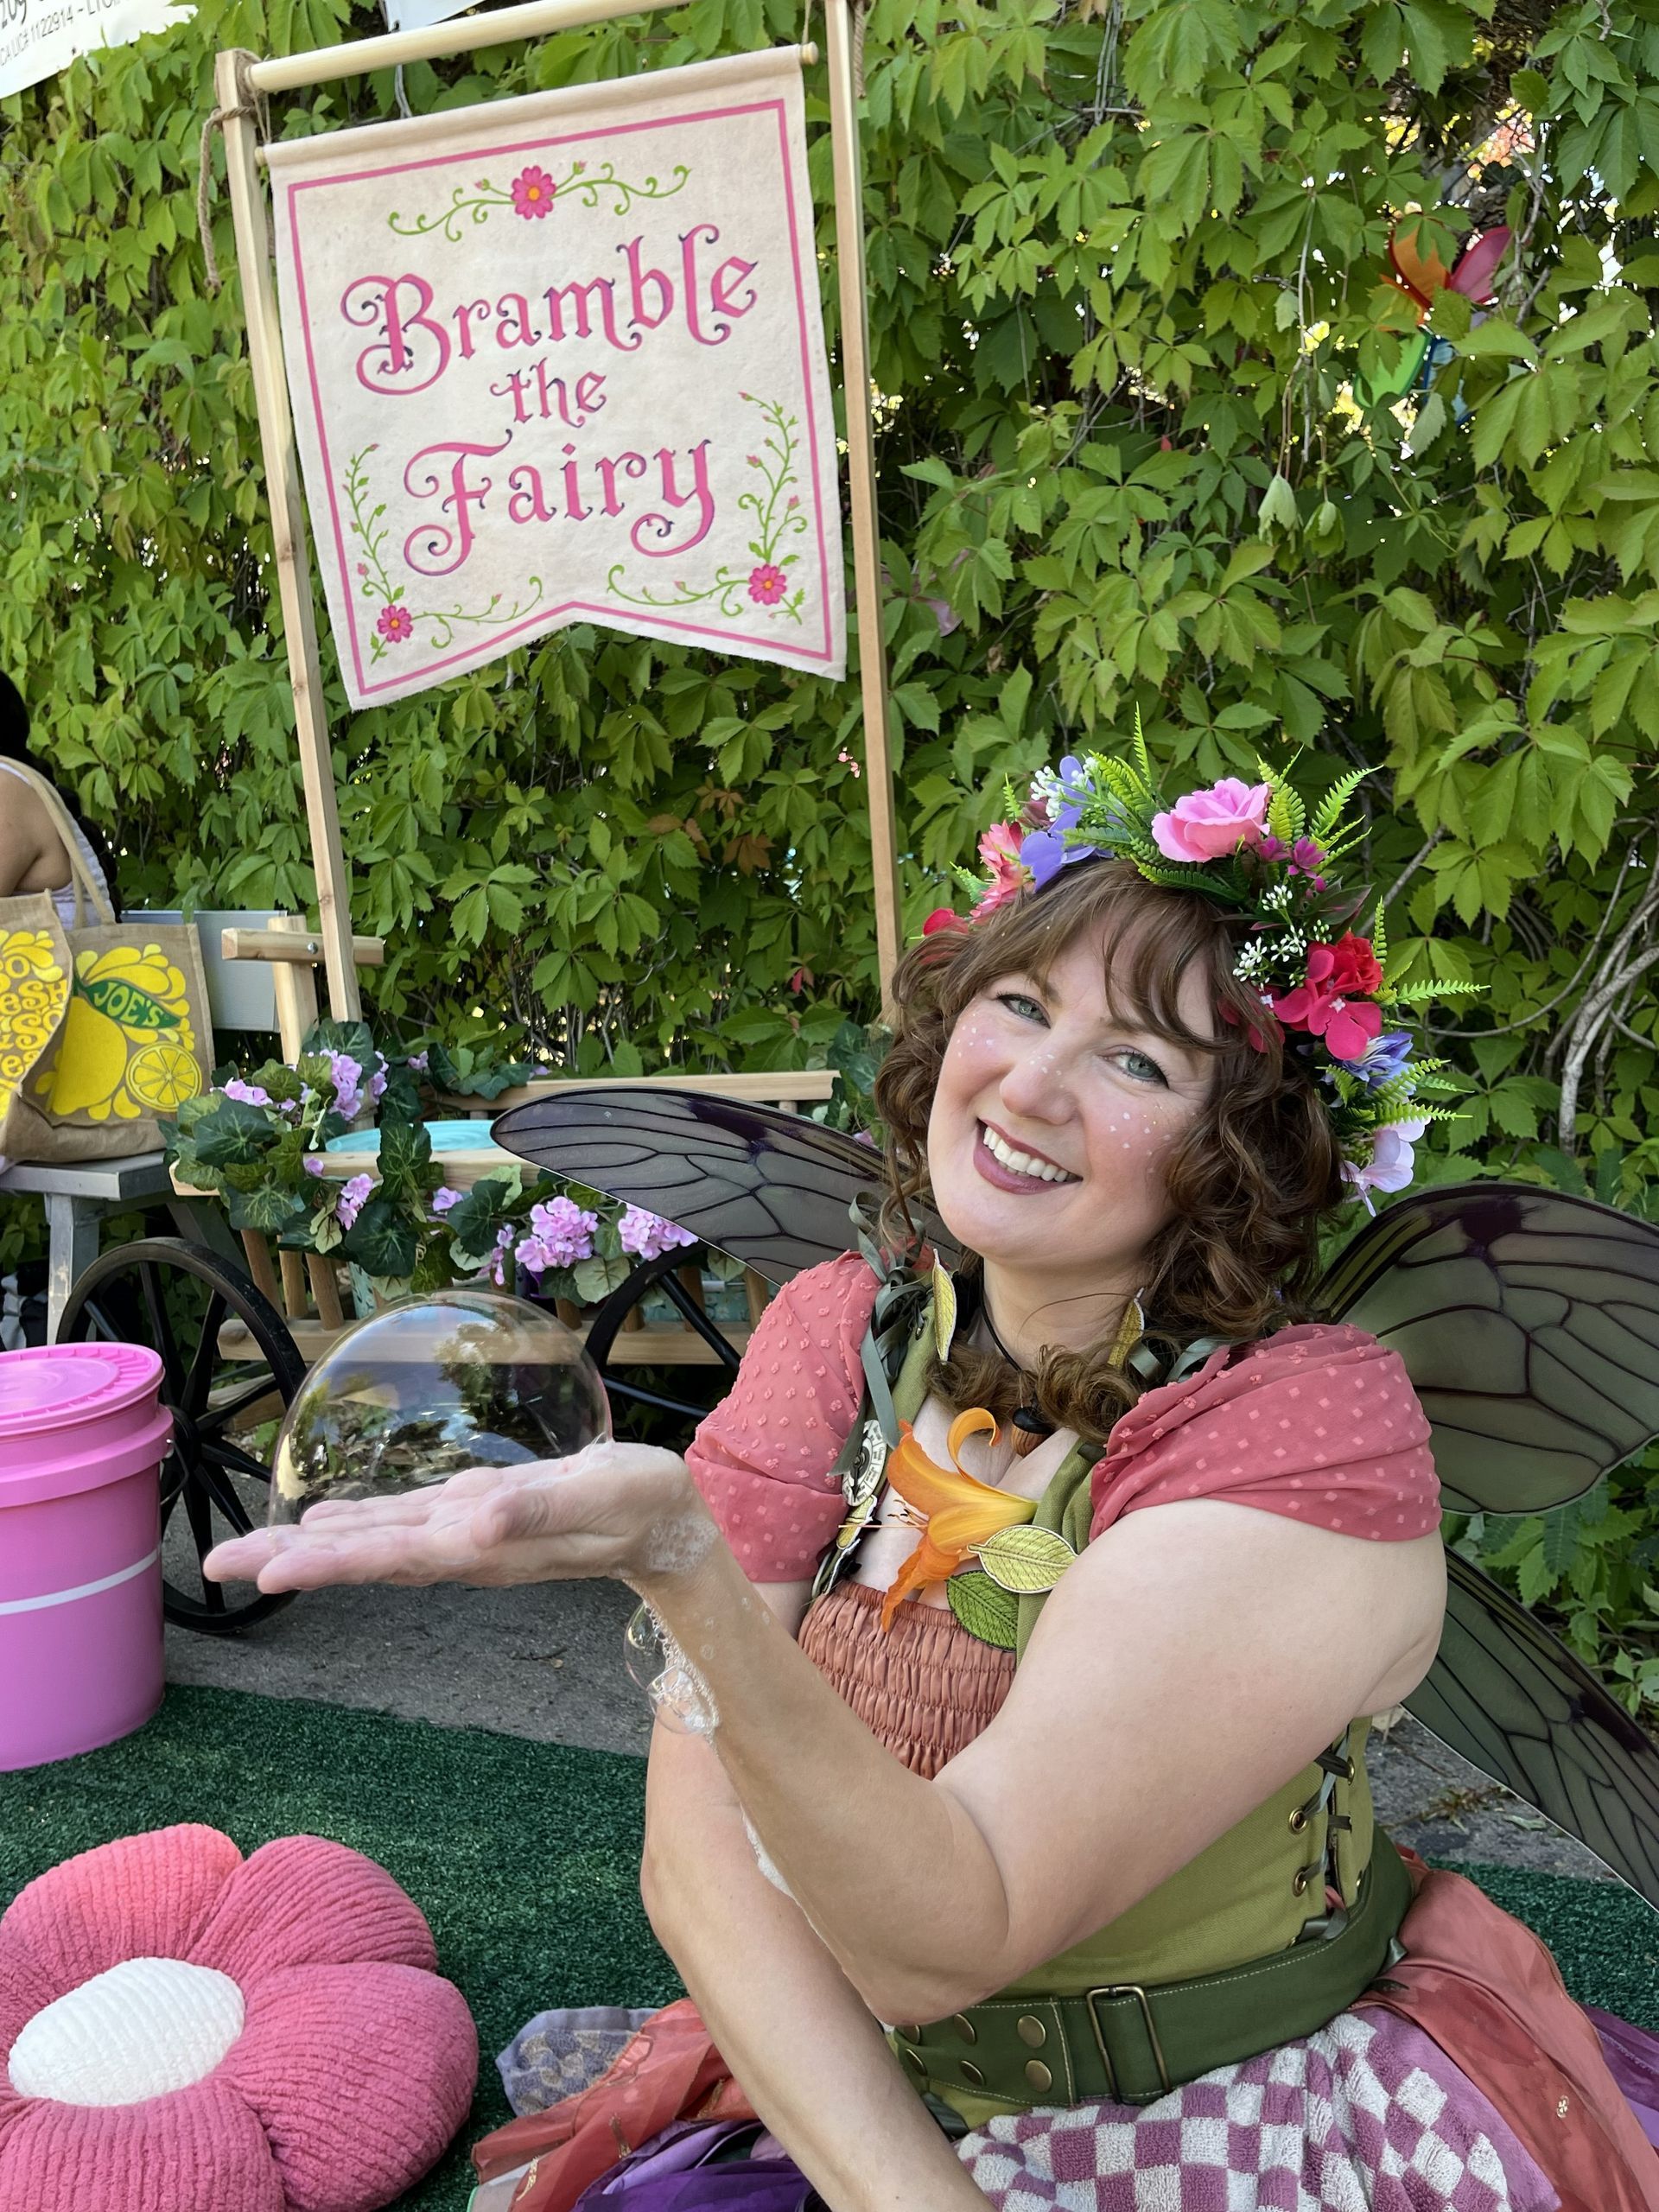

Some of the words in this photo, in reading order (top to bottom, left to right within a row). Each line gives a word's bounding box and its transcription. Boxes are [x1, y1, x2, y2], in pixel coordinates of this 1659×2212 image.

[340, 224, 758, 396] Bramble
[489, 357, 607, 429] the
[404, 429, 715, 577] Fairy
[93, 982, 164, 1027] JOE'S
